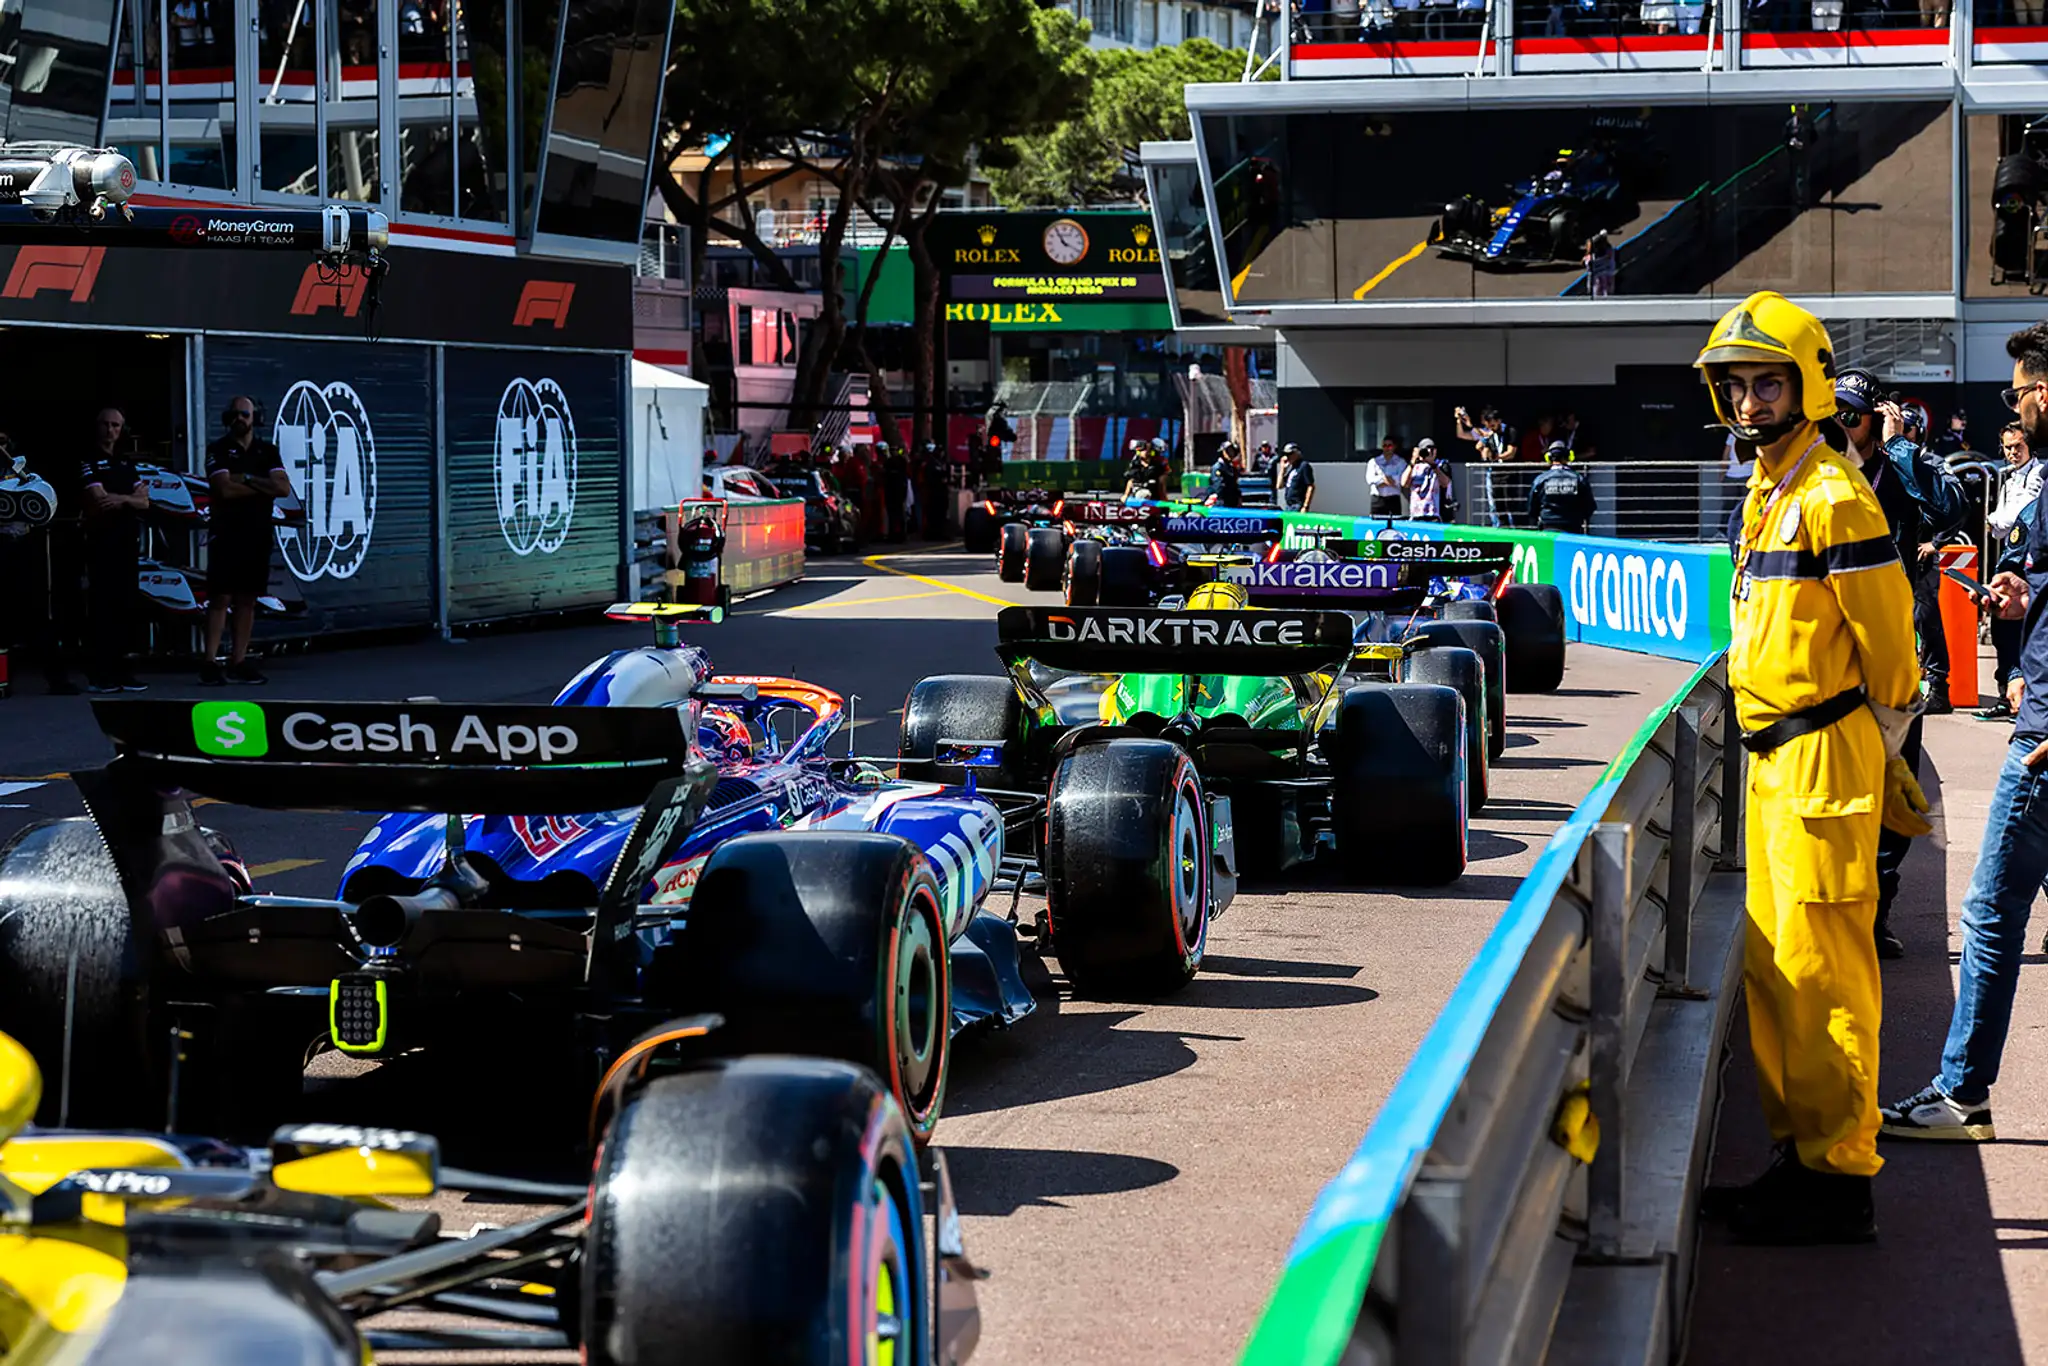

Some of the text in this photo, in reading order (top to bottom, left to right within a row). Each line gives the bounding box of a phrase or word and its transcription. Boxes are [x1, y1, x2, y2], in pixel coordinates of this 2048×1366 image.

[208, 219, 294, 235] MoneyGram
[207, 235, 294, 244] HAAS F1 TEAM
[954, 249, 1021, 263] ROLEX
[1108, 248, 1160, 263] ROLE
[993, 277, 1046, 287] FORMULA
[1055, 277, 1093, 287] GRAND
[1094, 277, 1120, 286] PRIX
[1026, 285, 1075, 295] MONACO
[512, 280, 576, 329] F1
[945, 302, 1063, 323] ROLEX
[500, 416, 569, 518] FIA
[1084, 505, 1151, 520] INEOS
[1187, 517, 1263, 532] kraken
[1386, 543, 1436, 559] Cash
[1439, 544, 1482, 561] App
[1259, 562, 1388, 588] kraken
[1569, 550, 1689, 642] aramco
[1048, 615, 1304, 646] DARKTRACE
[282, 712, 437, 753] Cash
[451, 715, 579, 762] App
[663, 858, 703, 894] HON
